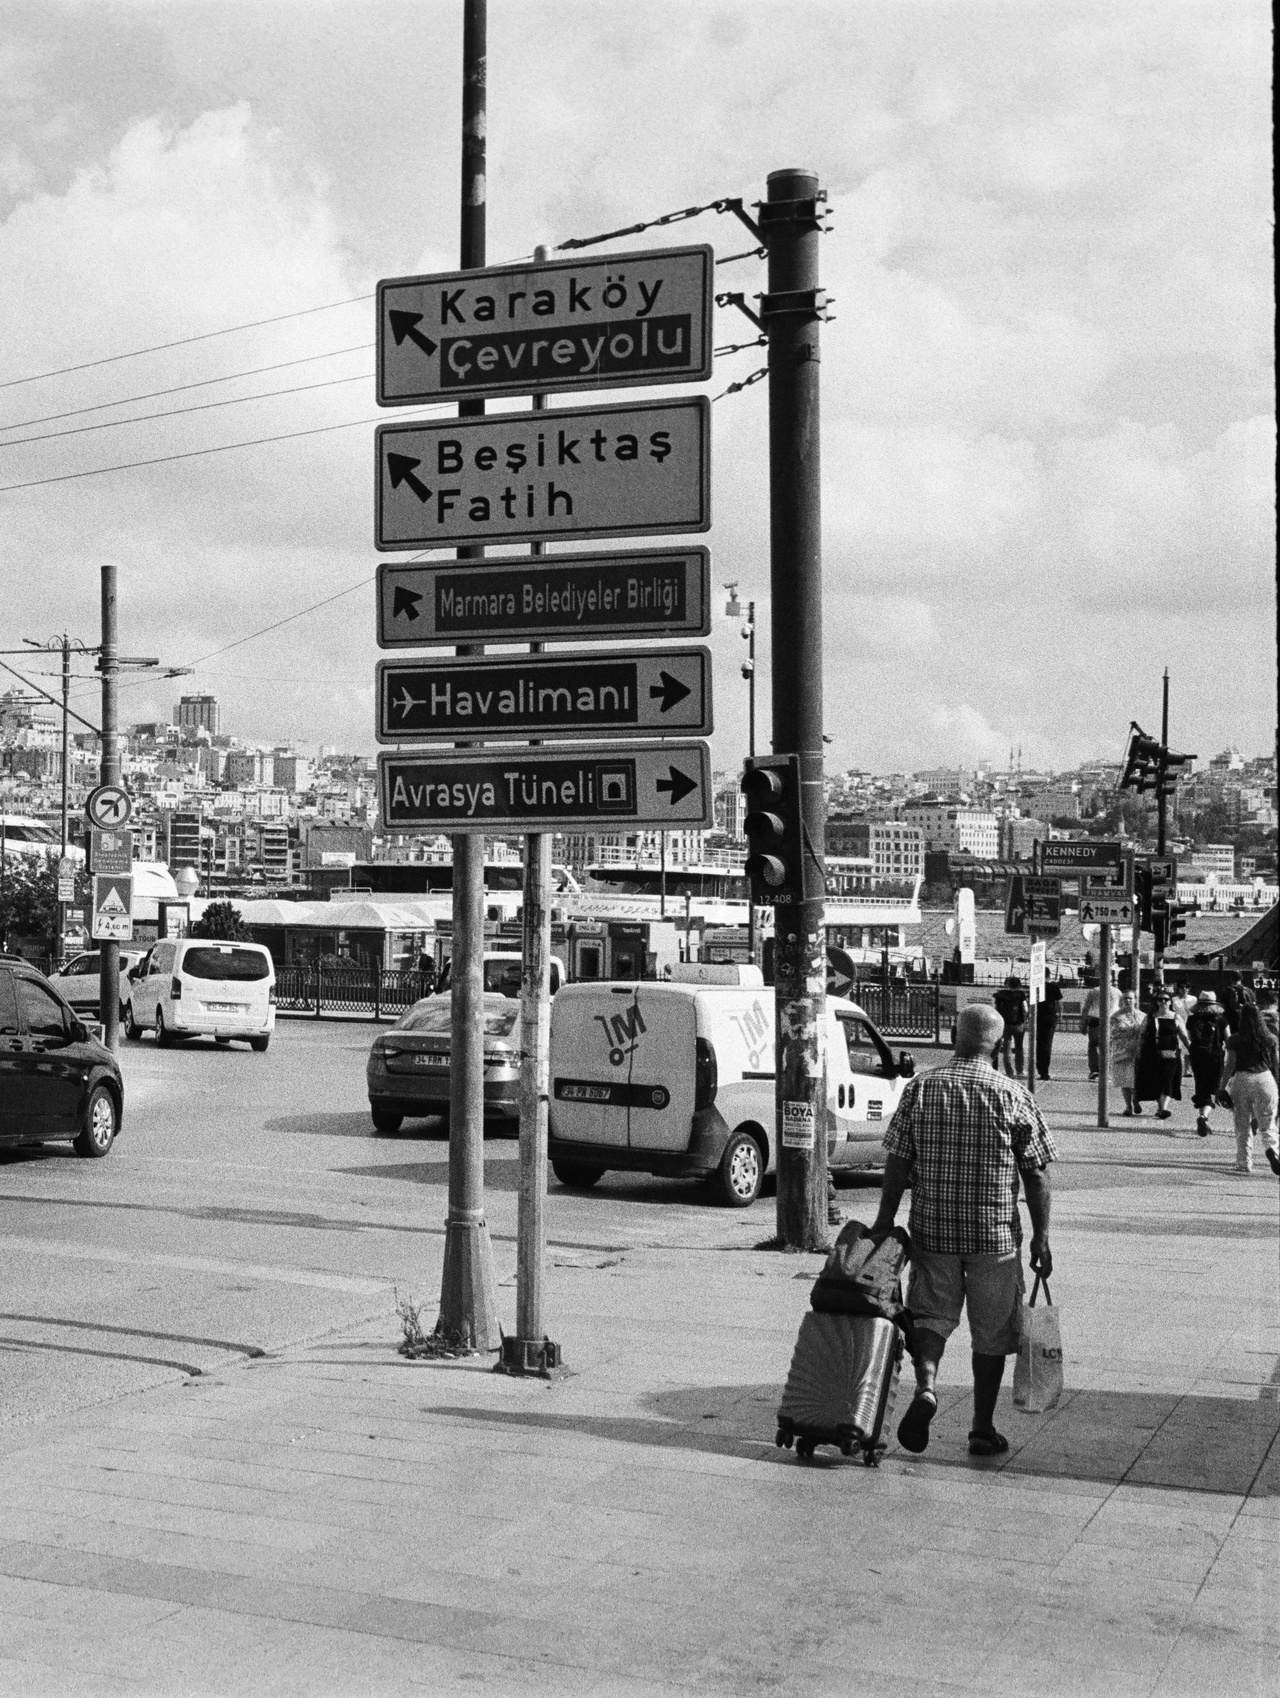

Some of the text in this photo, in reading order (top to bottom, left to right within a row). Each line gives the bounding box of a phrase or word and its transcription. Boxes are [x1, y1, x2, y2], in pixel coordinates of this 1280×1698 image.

[440, 274, 663, 325] Karaköy
[447, 321, 683, 379] Çevreyolu
[437, 429, 672, 475] Beşiktaş
[437, 481, 573, 524] Fatih
[441, 577, 678, 619] Marmara Belediyeler Birliği
[430, 679, 629, 715] Havalimanı
[391, 770, 593, 815] Avrasya Tüneli
[1045, 847, 1097, 857] KENNEDY
[759, 894, 792, 905] 12-408
[784, 1106, 813, 1117] BOYA
